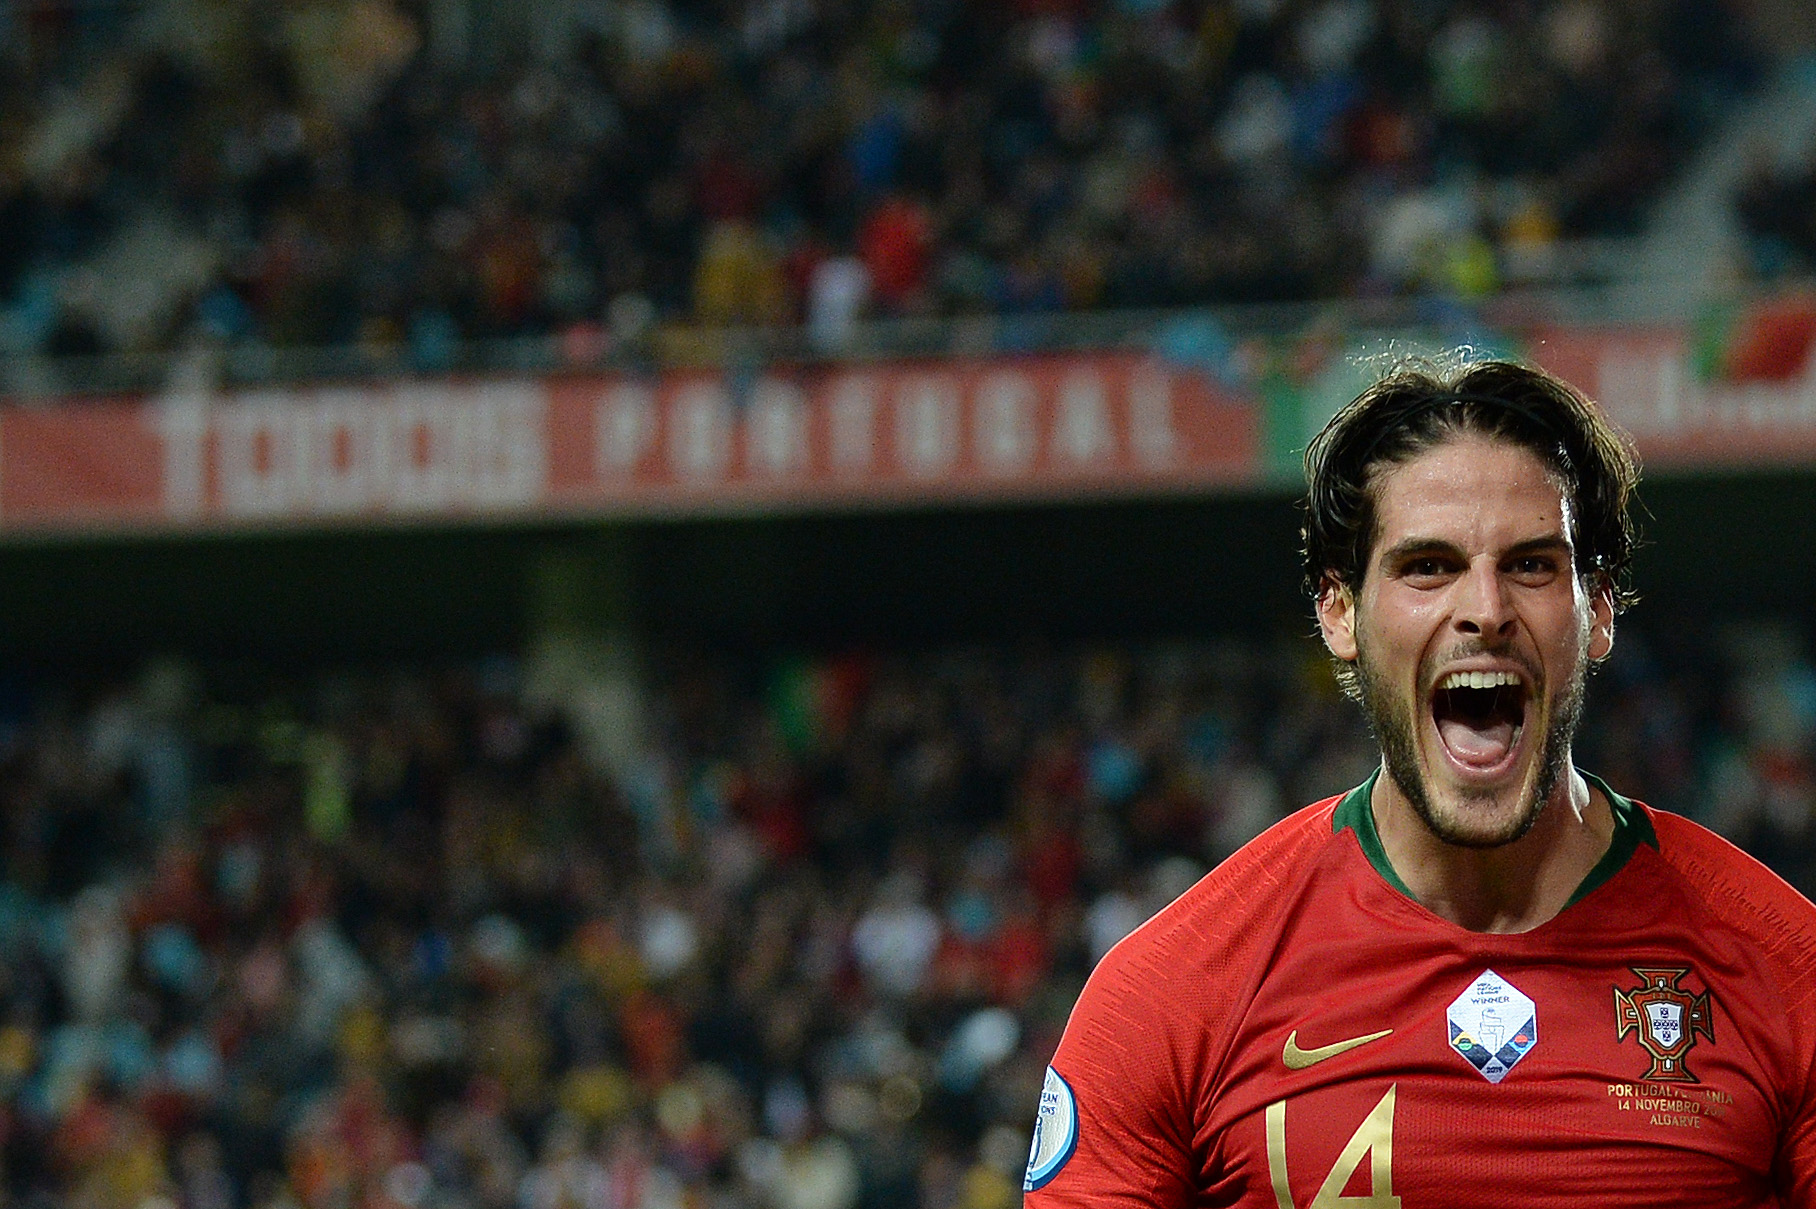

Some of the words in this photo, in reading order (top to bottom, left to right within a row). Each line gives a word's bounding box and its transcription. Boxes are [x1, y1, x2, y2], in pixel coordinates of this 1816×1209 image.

[158, 381, 547, 517] TODOS
[595, 362, 1175, 480] PORTUGAL
[1470, 996, 1510, 1005] WINNER
[1618, 1099, 1630, 1111] 14
[1635, 1099, 1701, 1114] NOVEMBRO
[1650, 1113, 1700, 1128] ALGARVE
